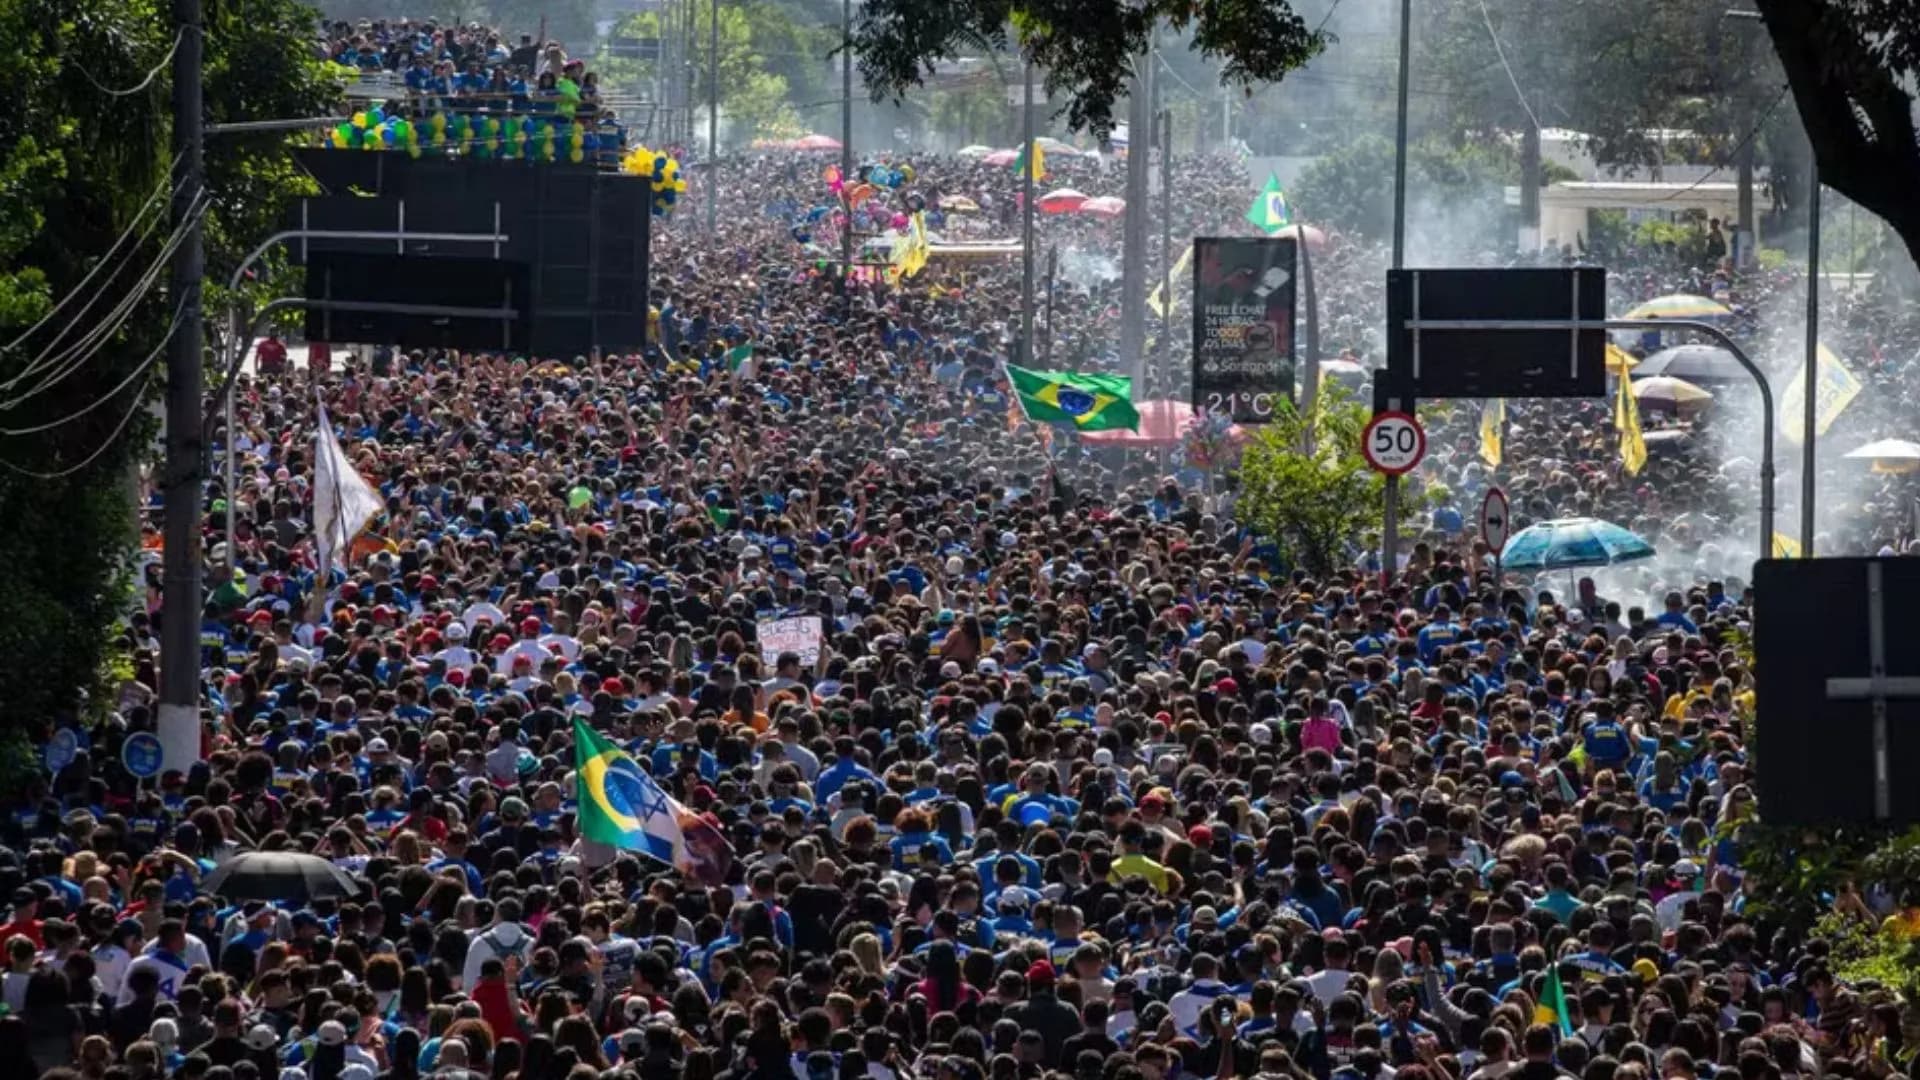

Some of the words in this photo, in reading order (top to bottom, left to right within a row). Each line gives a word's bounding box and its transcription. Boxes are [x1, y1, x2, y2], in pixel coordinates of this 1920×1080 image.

[1206, 328, 1240, 338] TODOS
[1208, 392, 1272, 415] 21°C
[1376, 426, 1415, 453] 50
